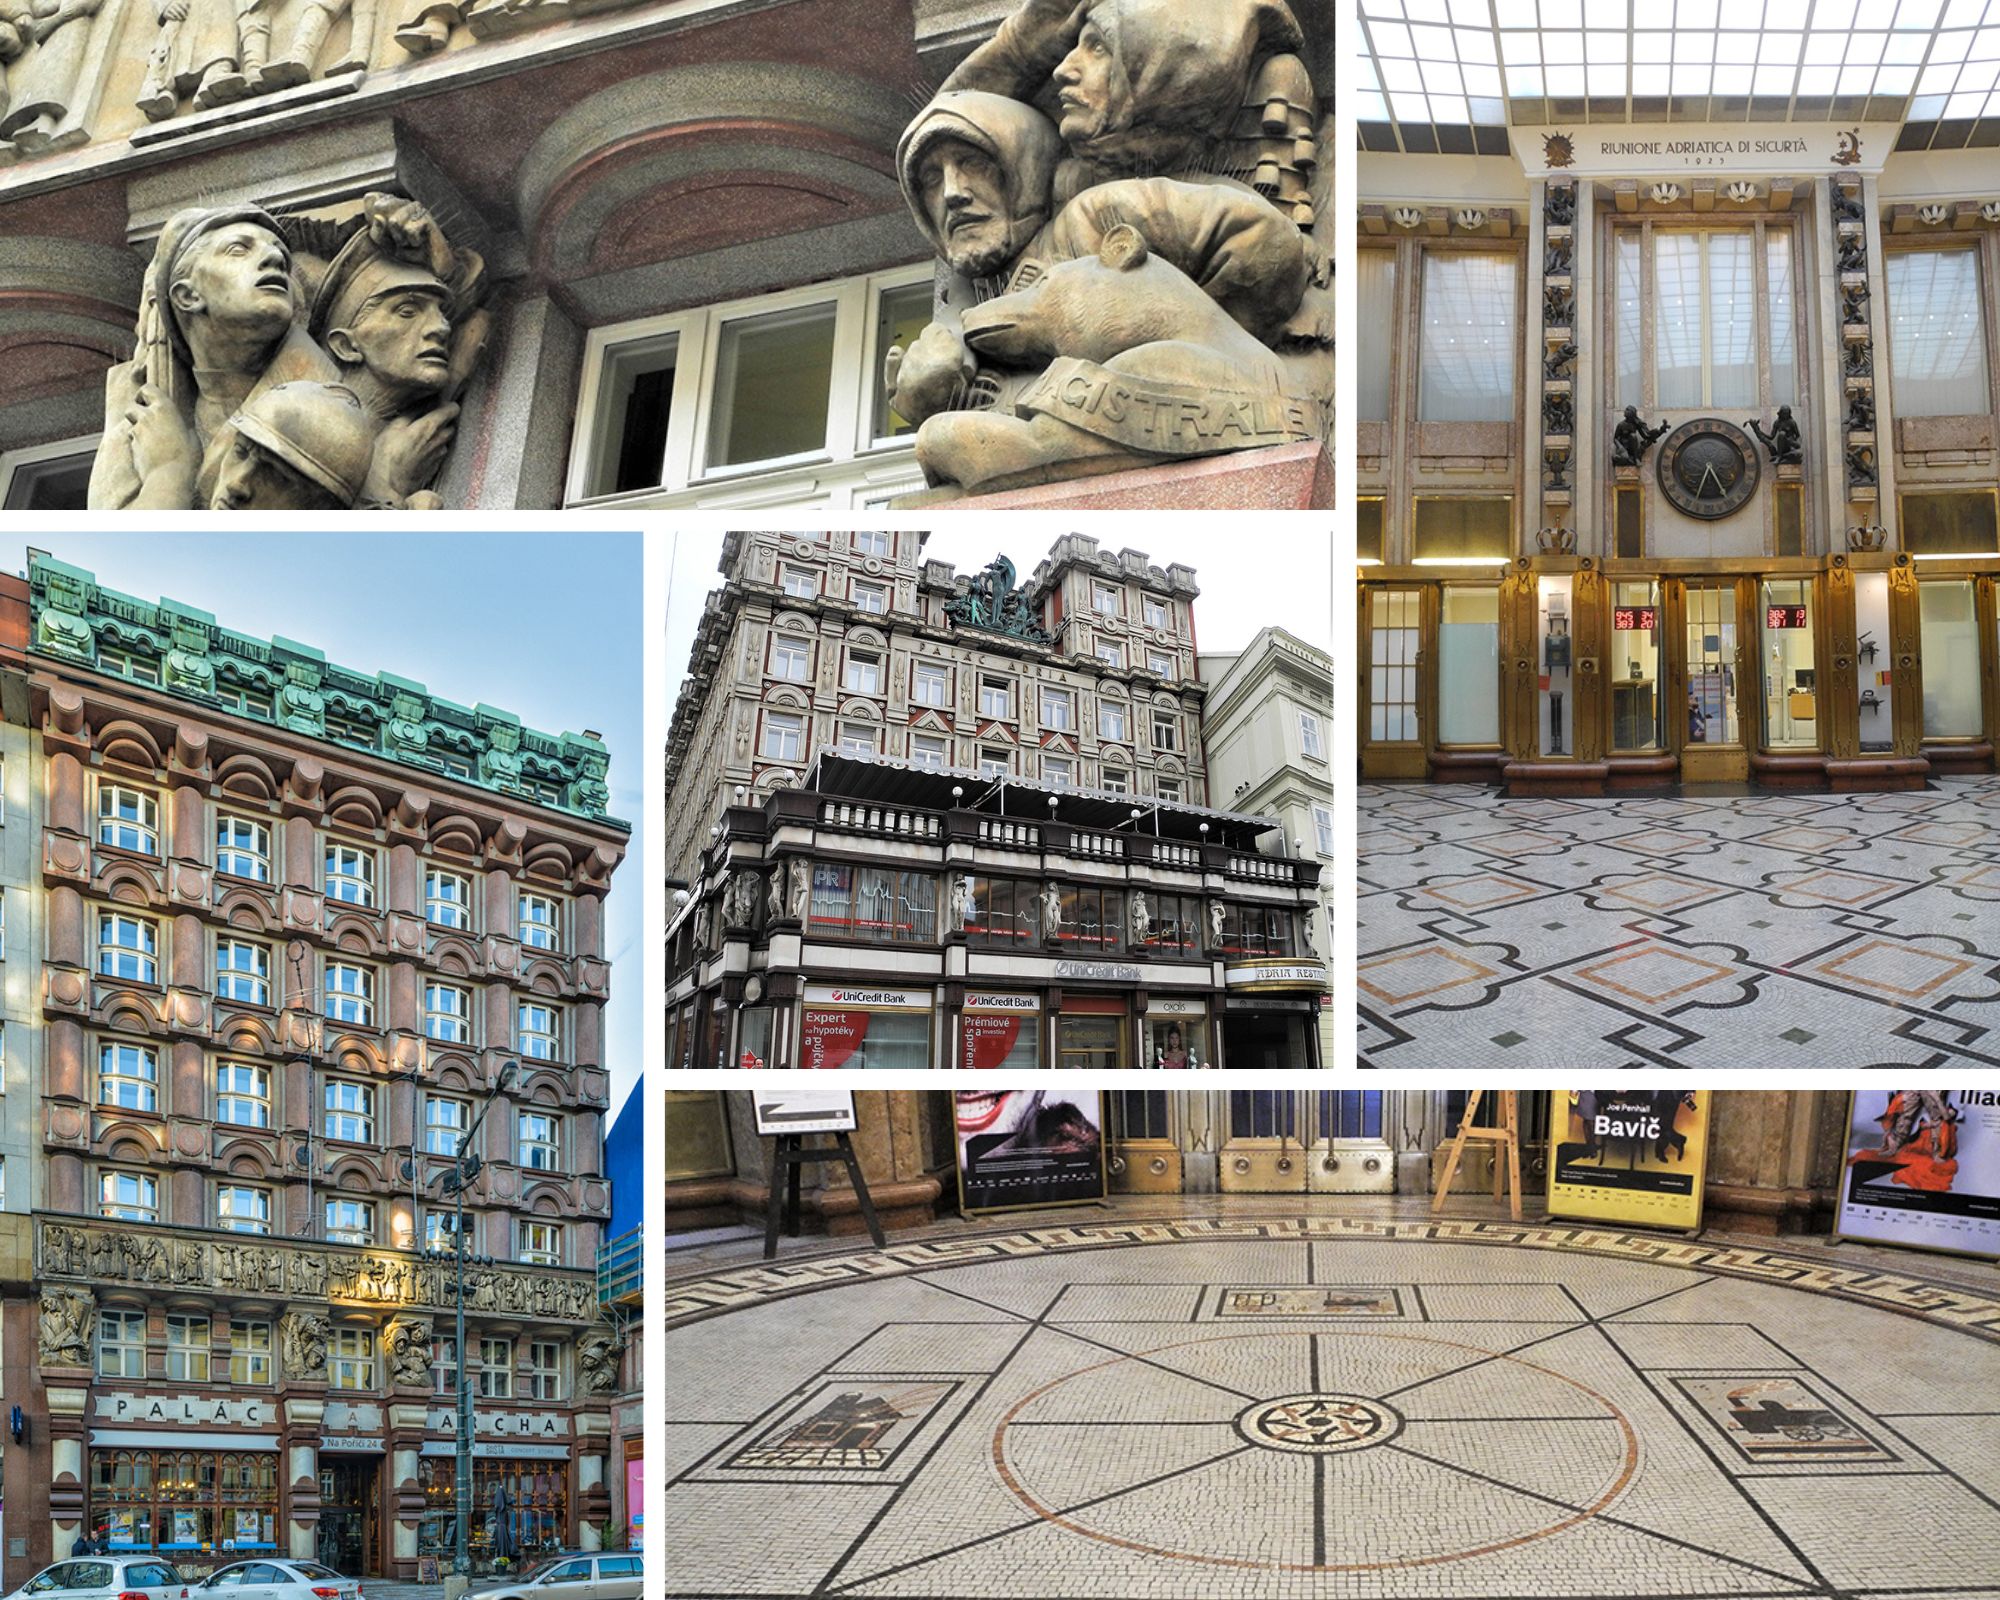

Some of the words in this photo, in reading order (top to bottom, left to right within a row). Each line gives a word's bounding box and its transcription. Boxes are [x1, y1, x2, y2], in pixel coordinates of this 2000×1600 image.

[1601, 142, 1662, 155] RIUNIONE
[1665, 141, 1734, 154] ADRIATICA
[1738, 140, 1750, 153] DI
[1616, 610, 1633, 620] 945
[1008, 661, 1067, 682] ADRIA
[1070, 962, 1117, 978] UniCredit
[1118, 966, 1142, 979] Bank
[1257, 968, 1291, 978] ADRIA
[843, 991, 883, 1003] UniCredit
[884, 993, 906, 1004] Bank
[978, 996, 1013, 1006] UniCredit
[1015, 997, 1034, 1007] Bank
[806, 1011, 846, 1024] Expert
[964, 1016, 1010, 1027] Prémiové
[813, 1025, 854, 1037] hypotéky
[976, 1028, 981, 1036] a
[805, 1037, 812, 1046] a
[1606, 1103, 1621, 1111] Joe
[1621, 1103, 1651, 1113] Penhall
[1594, 1115, 1661, 1140] Bavič
[117, 1400, 257, 1421] PALÁC
[327, 1438, 340, 1447] Na
[367, 1439, 377, 1449] 24
